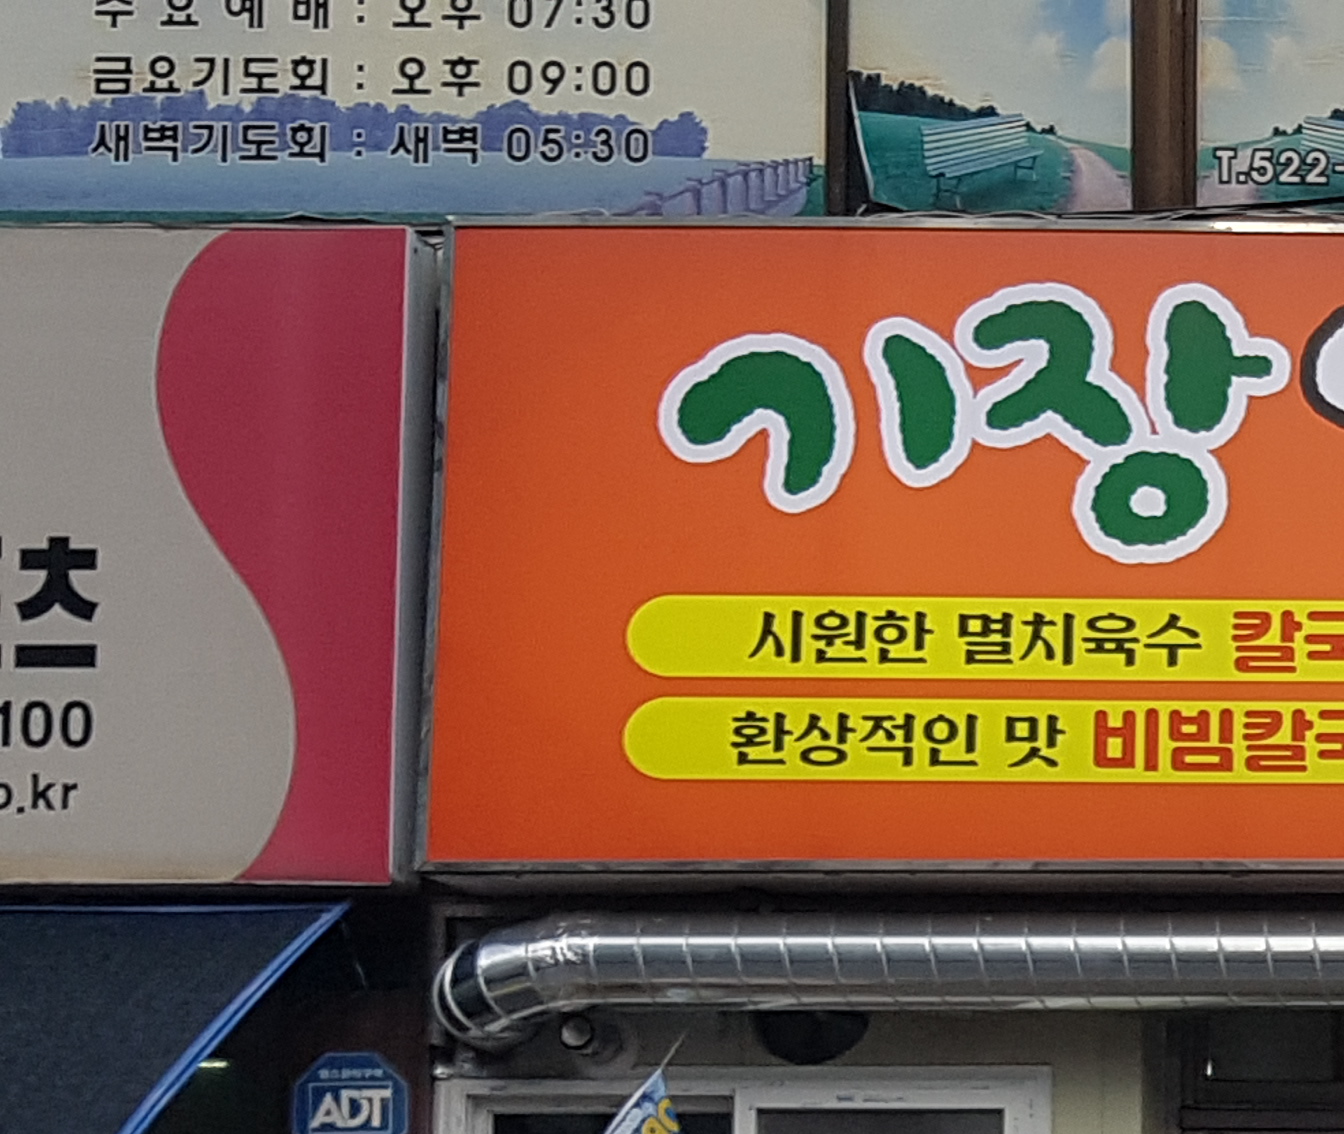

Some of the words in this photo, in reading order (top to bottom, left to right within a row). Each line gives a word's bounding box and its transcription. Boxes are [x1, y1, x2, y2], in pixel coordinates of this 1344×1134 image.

[508, 0, 651, 28] 07:30
[93, 56, 329, 96] 금요기도회
[391, 57, 481, 97] 오후
[508, 61, 651, 95] 09:00
[91, 124, 328, 163] 새벽기도회
[390, 125, 479, 164] 새벽
[507, 128, 651, 162] 05:30
[659, 283, 1290, 563] 기장
[0, 536, 98, 668] 츠
[749, 610, 933, 668] 시원한
[956, 611, 1203, 667] 멸치육수
[730, 713, 979, 770] 환상적인
[1004, 715, 1065, 770] 맛
[309, 1089, 391, 1128] ADT
